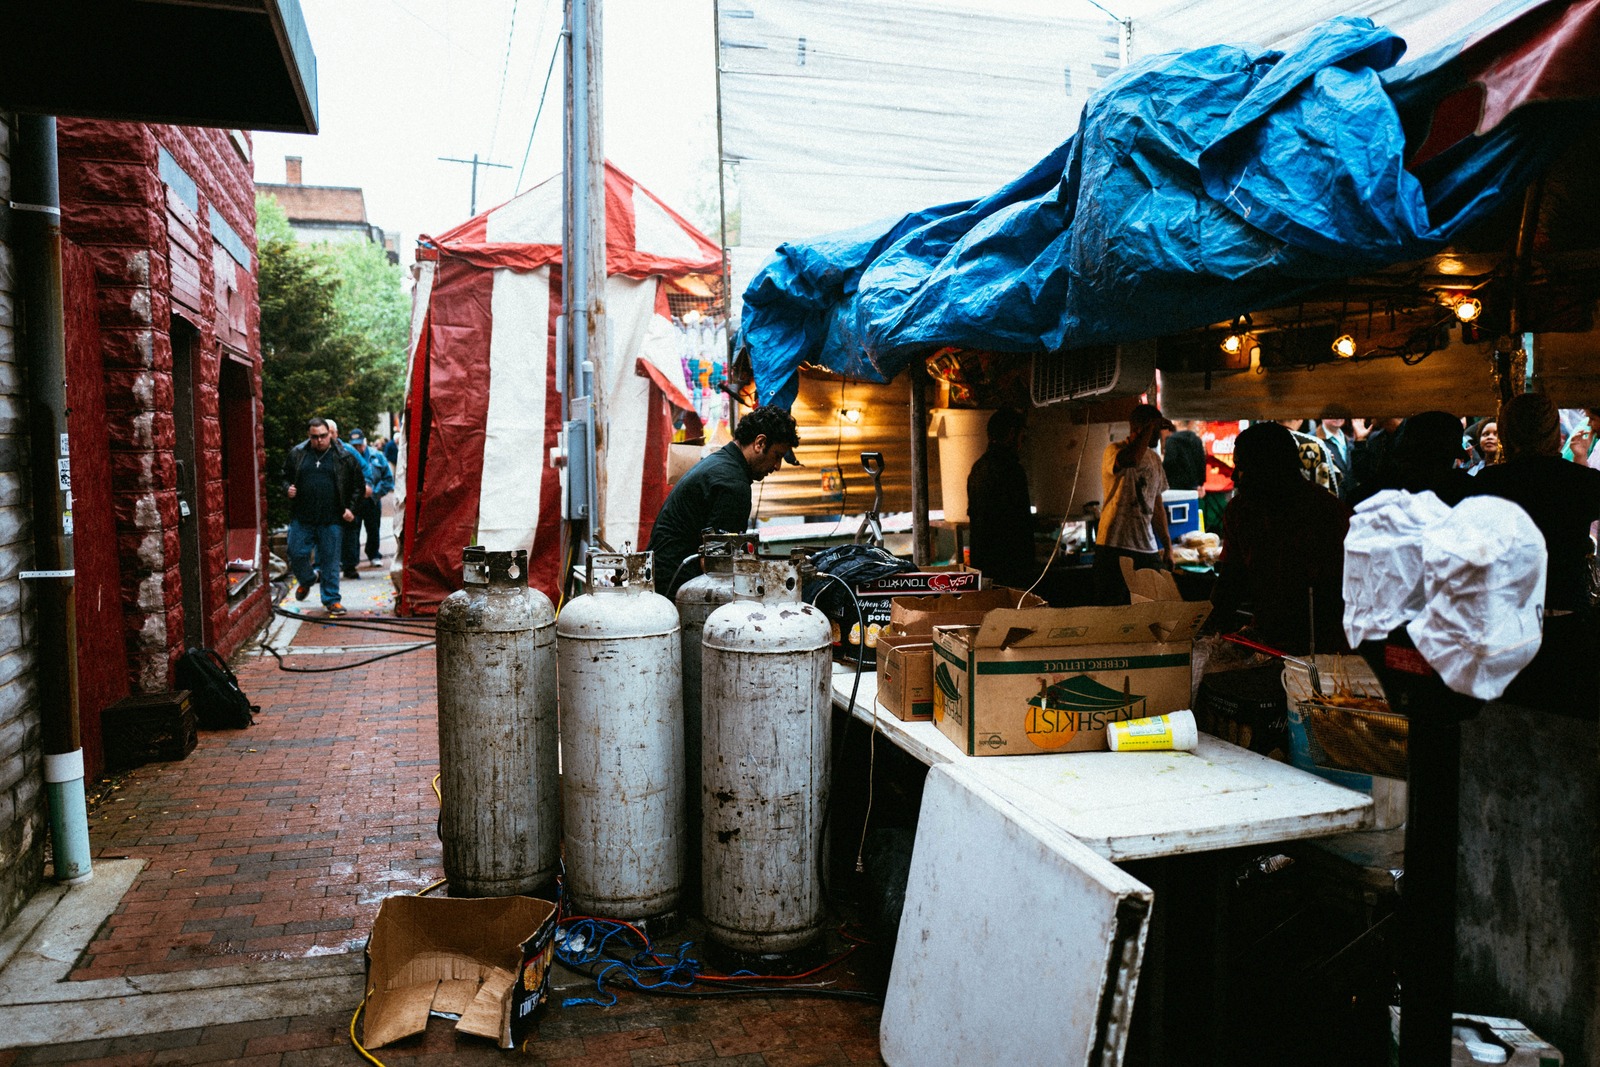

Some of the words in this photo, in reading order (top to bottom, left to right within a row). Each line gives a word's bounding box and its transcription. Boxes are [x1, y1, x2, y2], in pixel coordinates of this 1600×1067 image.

[949, 575, 974, 587] USA
[1044, 662, 1086, 671] LETTUCE
[1089, 659, 1129, 670] ICEBERG
[1026, 699, 1147, 735] ESHKIST
